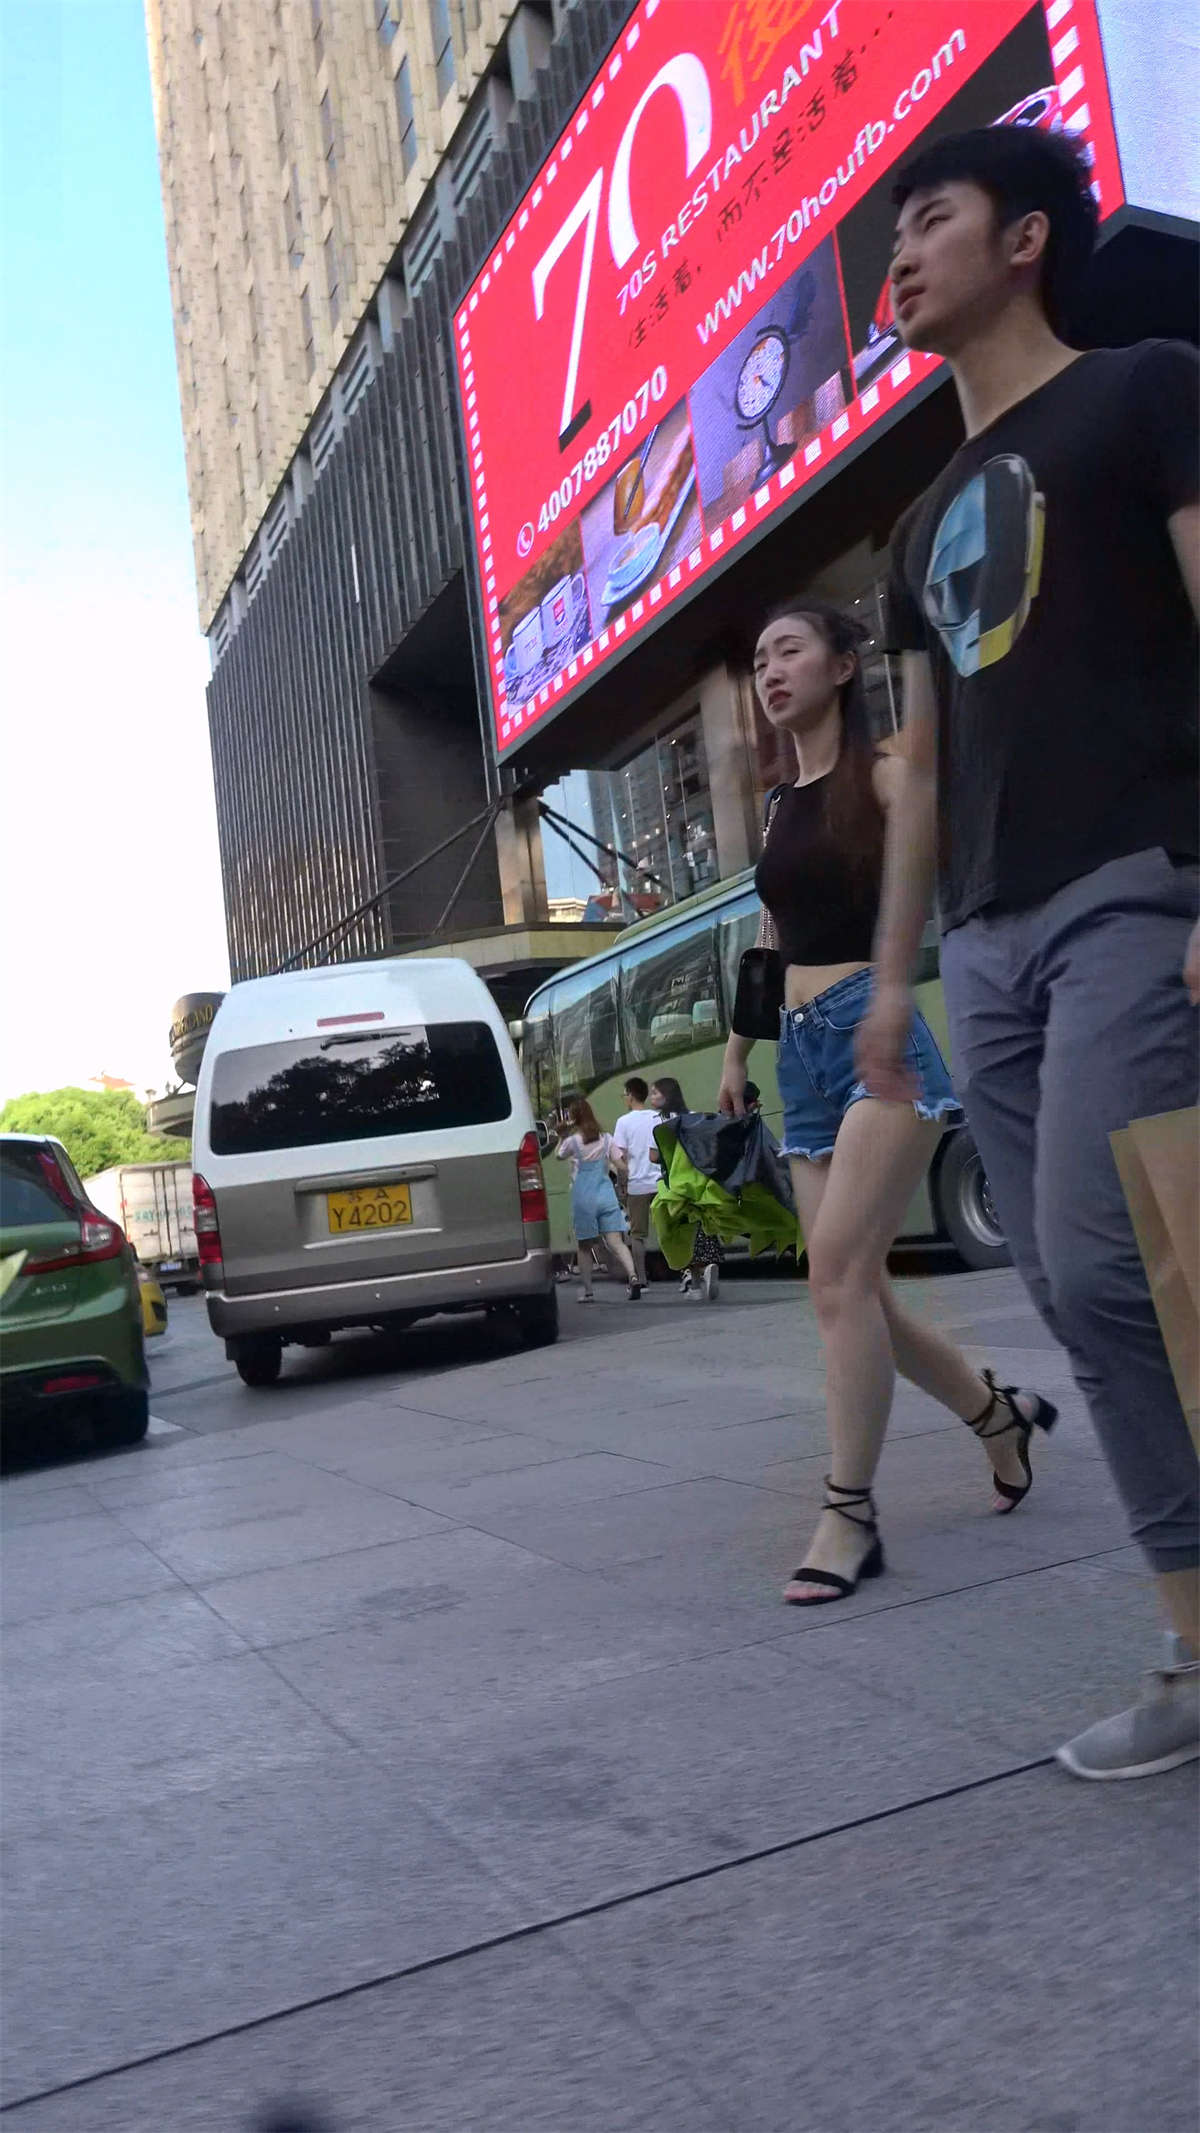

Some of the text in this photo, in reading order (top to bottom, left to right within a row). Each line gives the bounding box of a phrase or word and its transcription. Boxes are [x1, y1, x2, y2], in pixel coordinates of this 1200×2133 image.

[616, 0, 842, 316] 70S RESTAURANT
[696, 28, 966, 344] www.70houfb.com
[537, 365, 667, 532] 4007887070
[333, 1200, 409, 1229] Y4202
